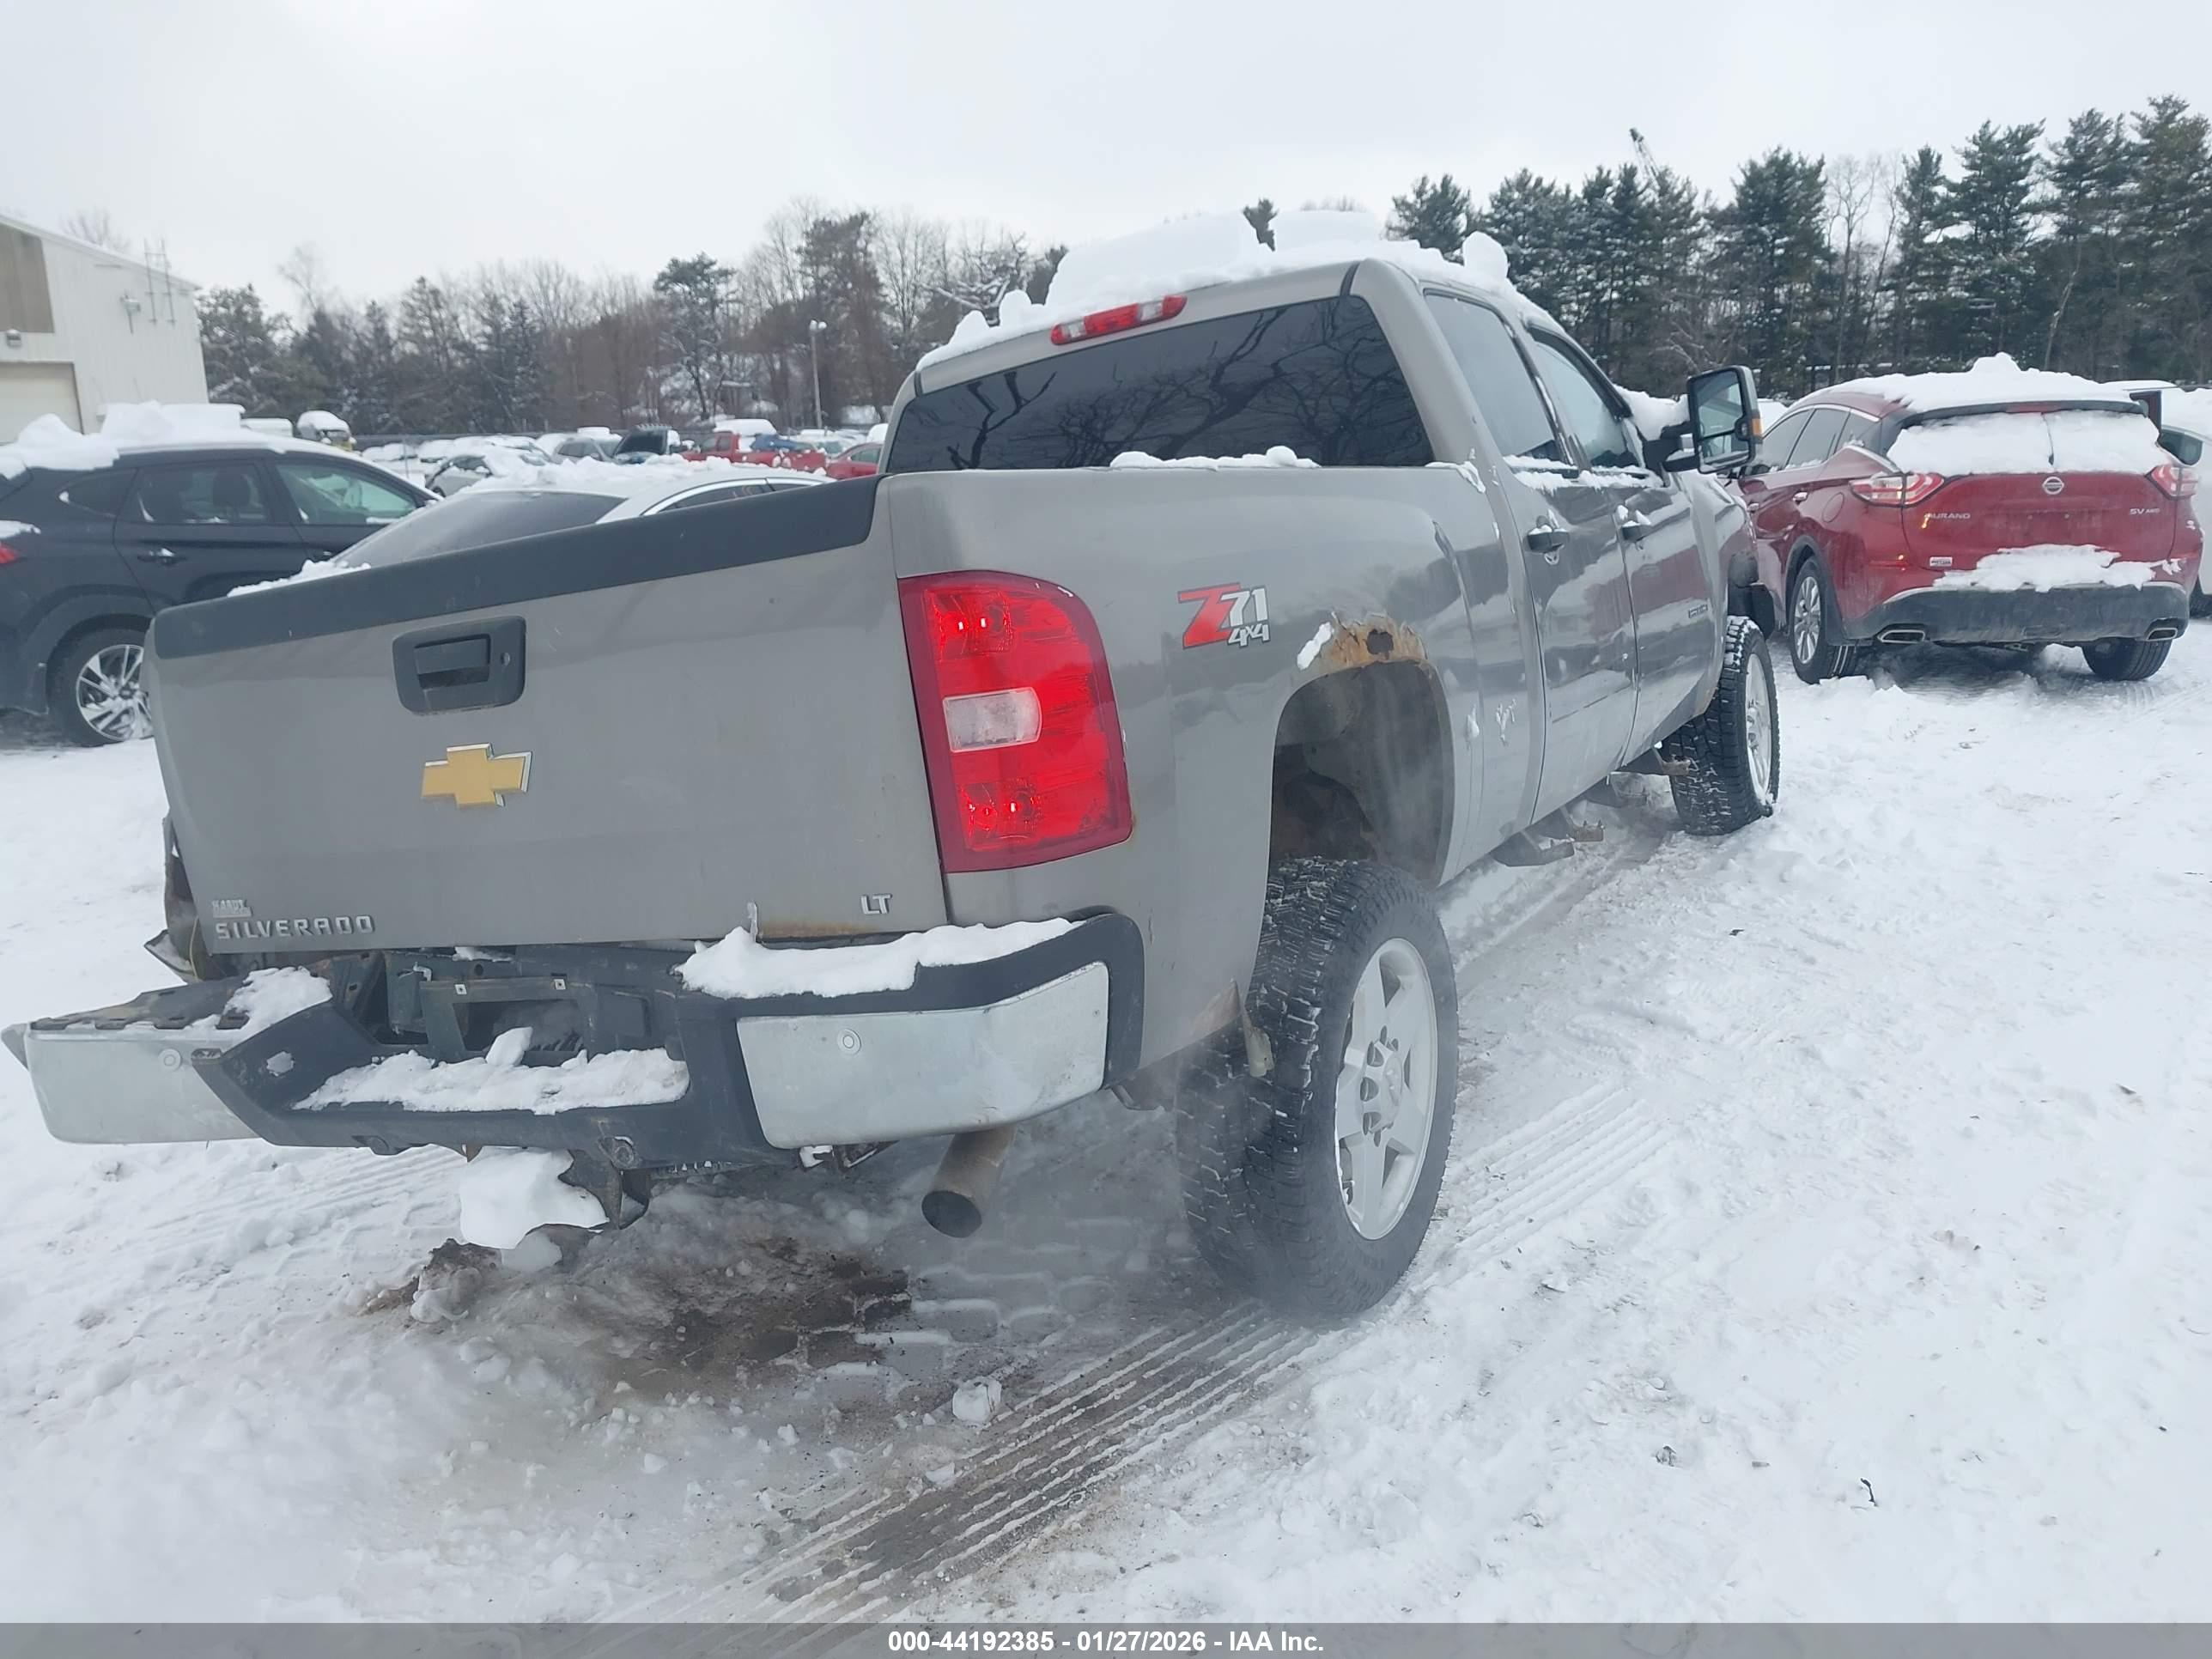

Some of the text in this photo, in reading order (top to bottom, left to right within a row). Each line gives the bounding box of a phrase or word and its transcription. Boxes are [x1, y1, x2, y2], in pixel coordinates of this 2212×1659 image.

[1177, 582, 1269, 649] Z71
[860, 894, 891, 915] LT
[216, 915, 374, 939] SILVERADO
